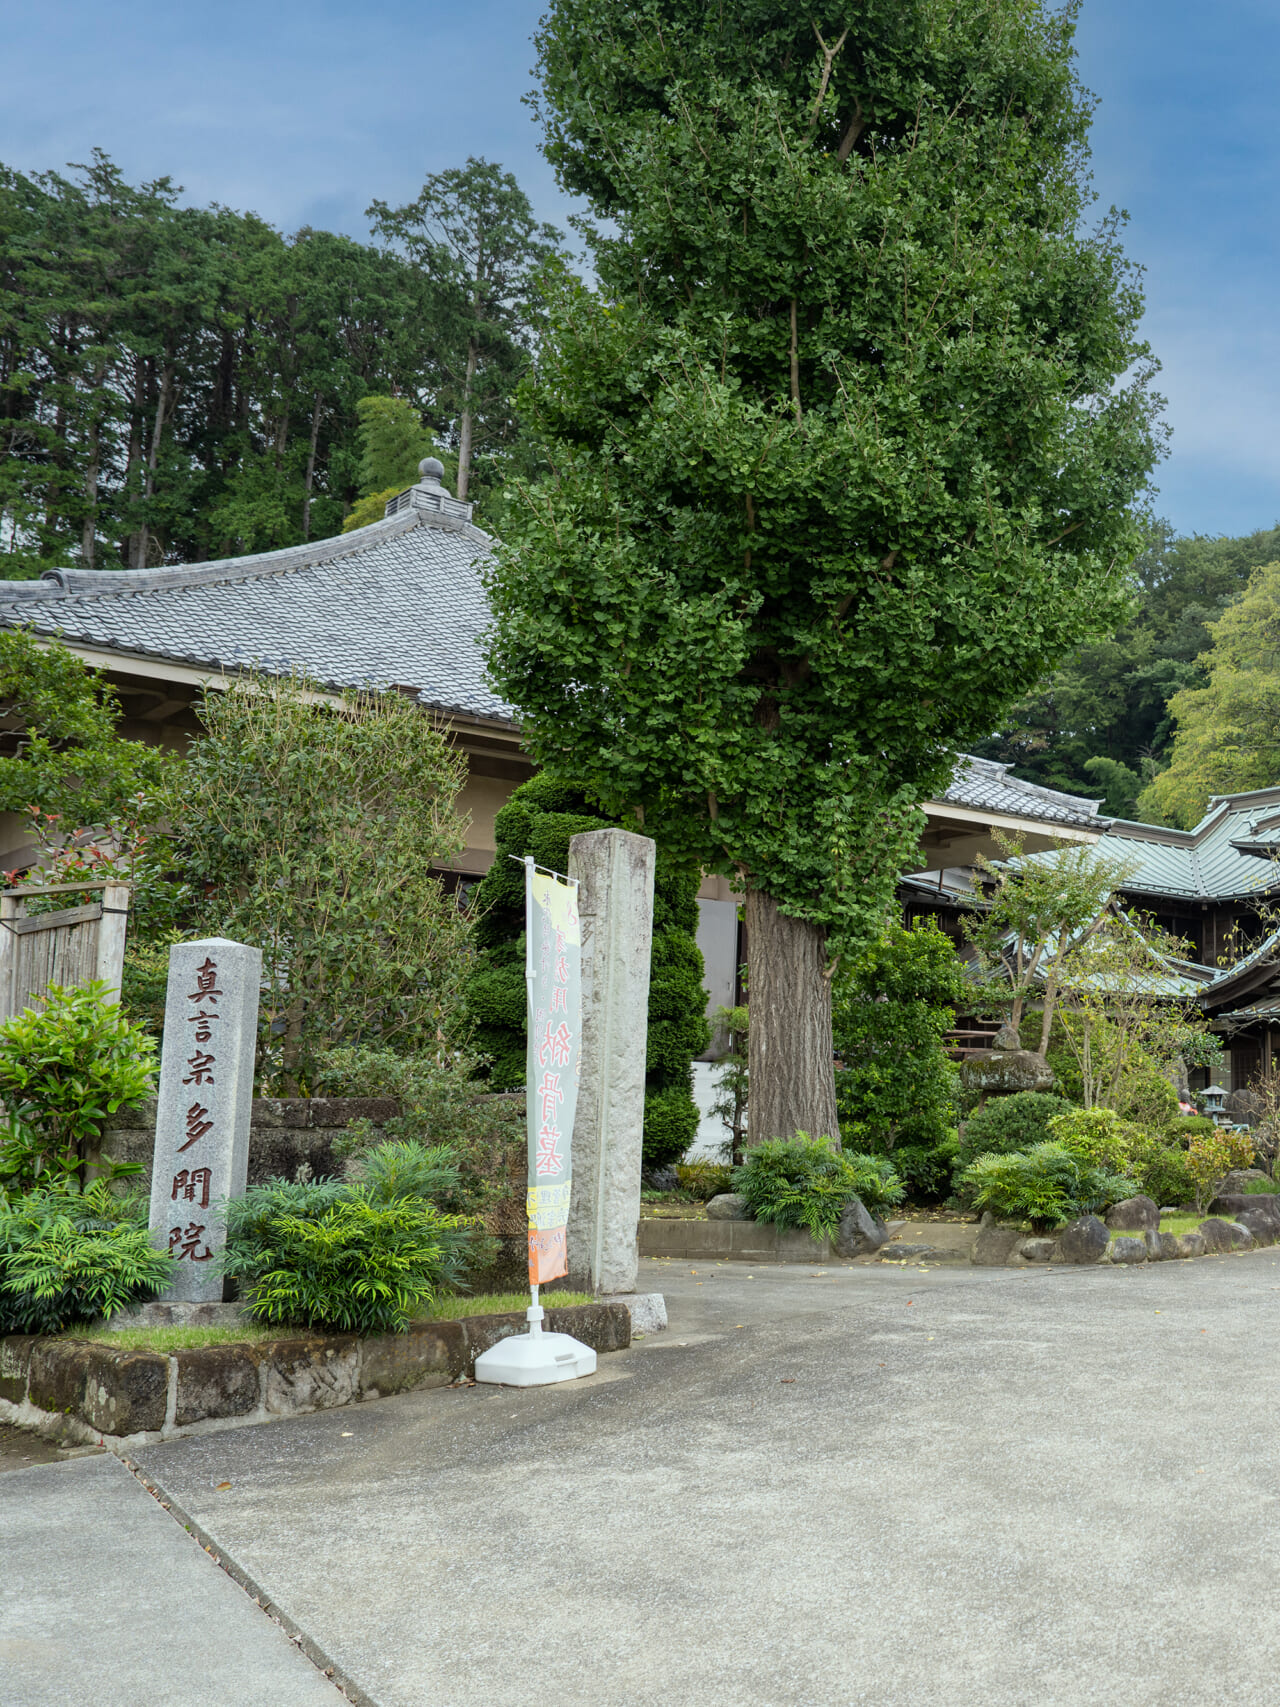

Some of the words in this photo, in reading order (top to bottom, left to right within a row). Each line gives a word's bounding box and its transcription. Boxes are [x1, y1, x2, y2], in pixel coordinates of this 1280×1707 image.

[168, 957, 223, 1263] 真言宗多聞院
